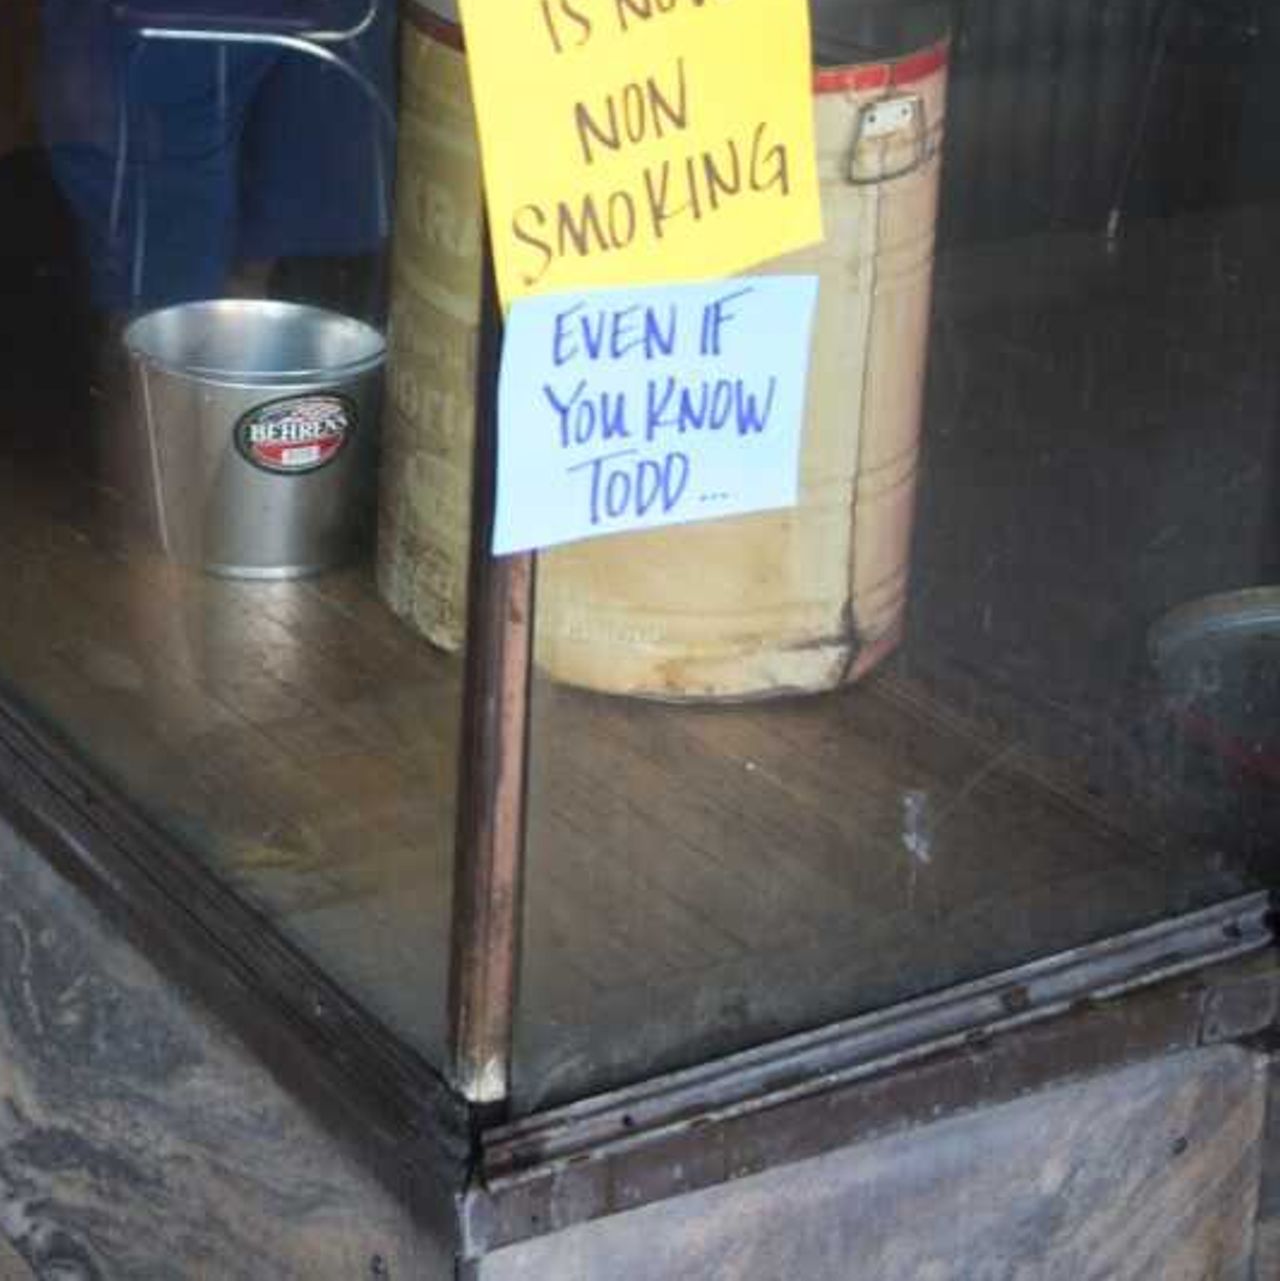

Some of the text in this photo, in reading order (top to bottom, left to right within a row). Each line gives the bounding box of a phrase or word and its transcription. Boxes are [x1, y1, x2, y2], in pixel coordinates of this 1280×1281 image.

[573, 57, 688, 165] NON
[512, 122, 790, 286] SMOKING
[552, 287, 755, 367] EVEN IF
[250, 417, 348, 442] BEHRENS
[645, 375, 777, 442] KNOW
